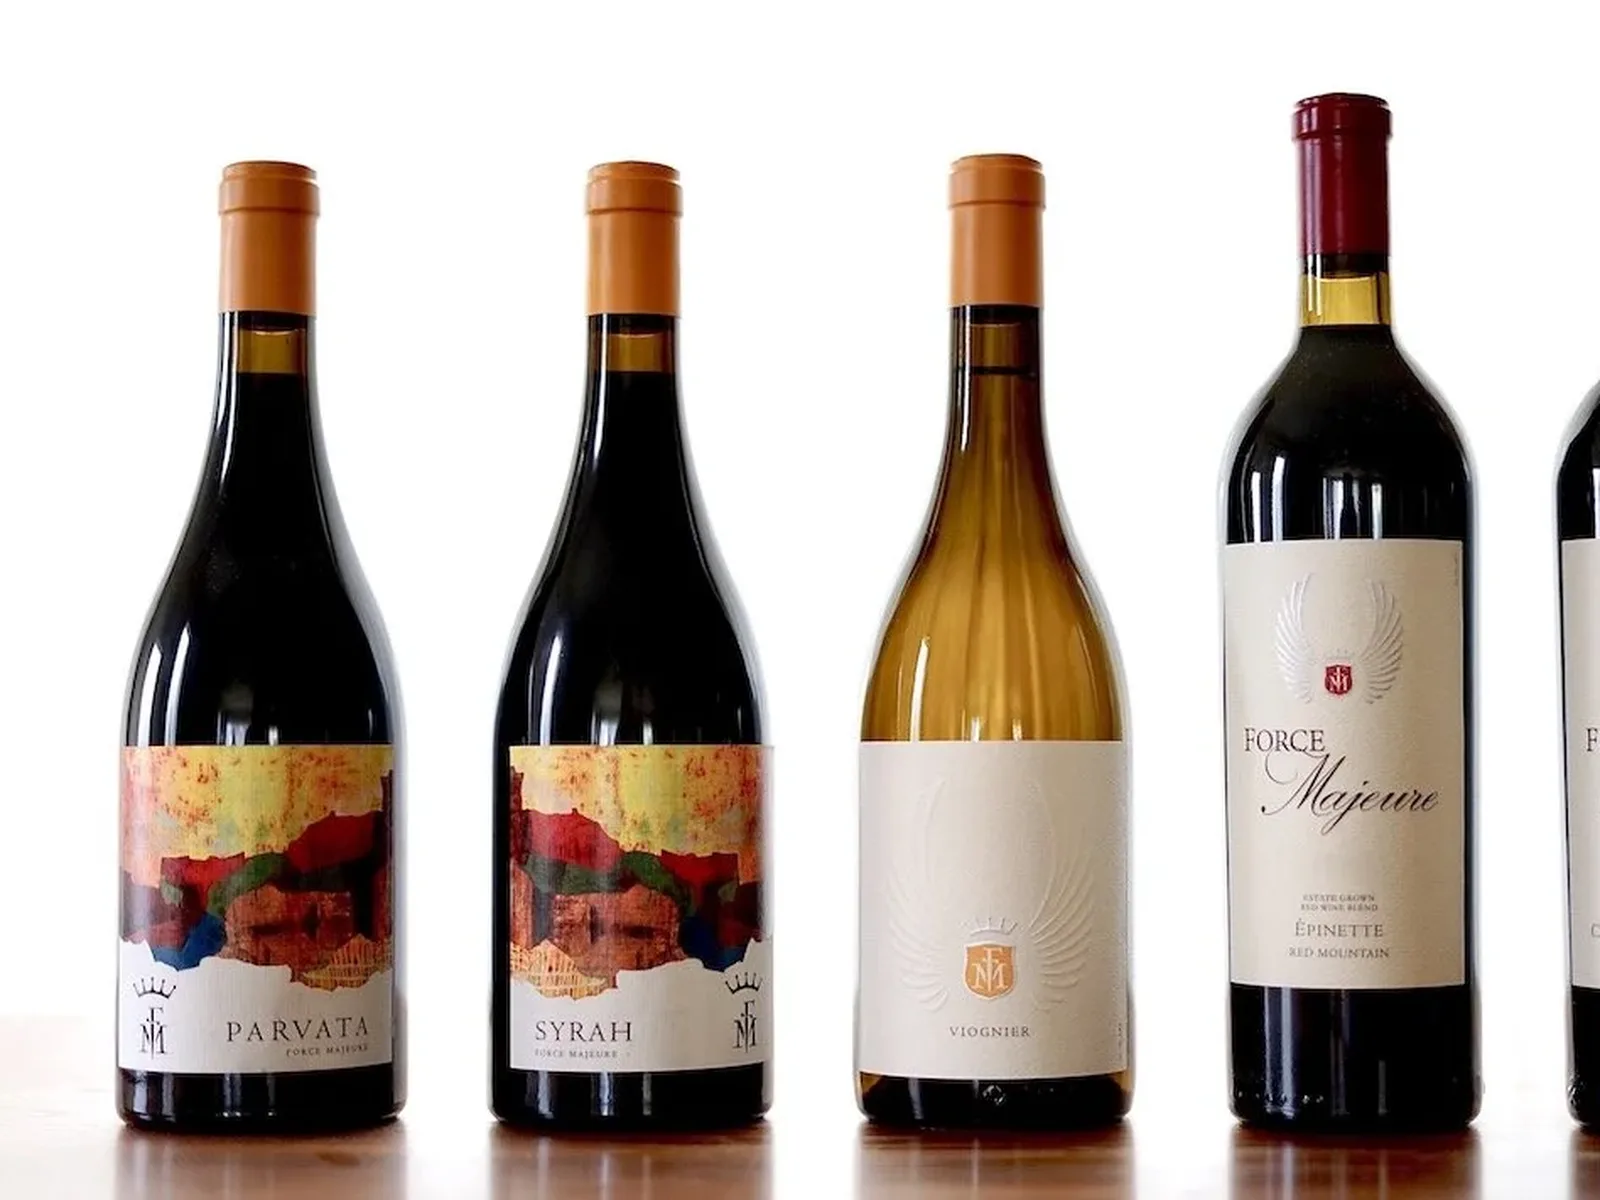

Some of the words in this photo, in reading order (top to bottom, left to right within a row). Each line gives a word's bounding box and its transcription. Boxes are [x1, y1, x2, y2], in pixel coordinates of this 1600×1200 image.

[1244, 728, 1325, 752] FORCE
[1261, 750, 1439, 835] Majeure
[1347, 903, 1378, 911] BLEND
[1295, 917, 1383, 937] ÉPINETTE
[1288, 947, 1314, 957] RED
[1317, 948, 1390, 958] MOUNTAIN
[227, 1016, 369, 1042] PARVATA
[535, 1021, 633, 1042] SYRAH
[949, 1026, 1031, 1038] VIOGNIER
